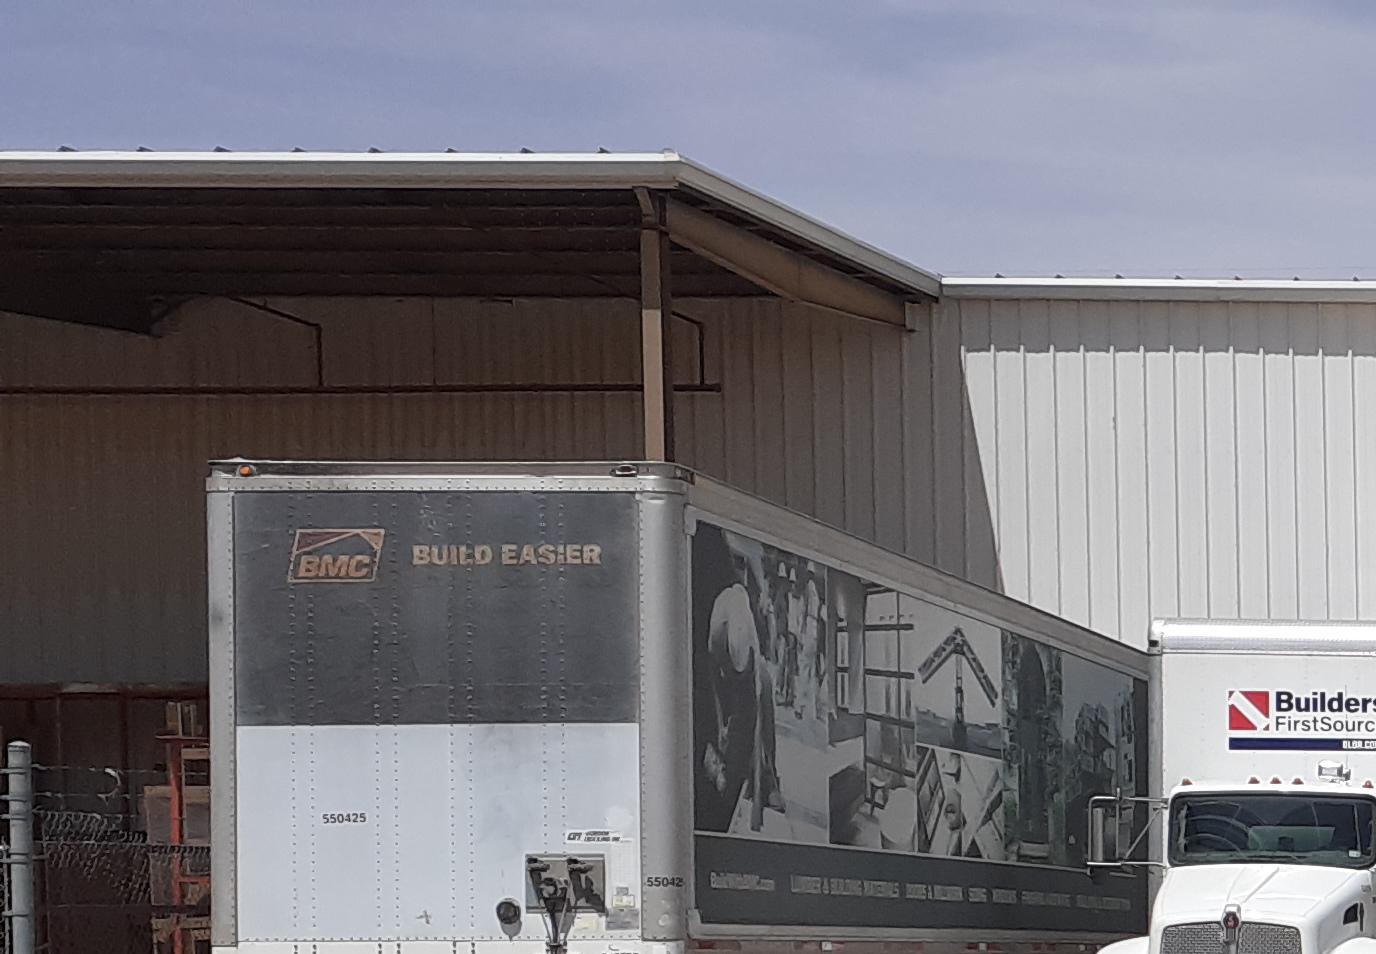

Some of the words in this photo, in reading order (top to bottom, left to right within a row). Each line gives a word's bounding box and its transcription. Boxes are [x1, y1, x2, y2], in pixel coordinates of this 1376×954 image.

[299, 554, 372, 578] BMC
[412, 544, 493, 565] BUILD
[501, 543, 601, 566] EASIER
[322, 812, 367, 825] 550425
